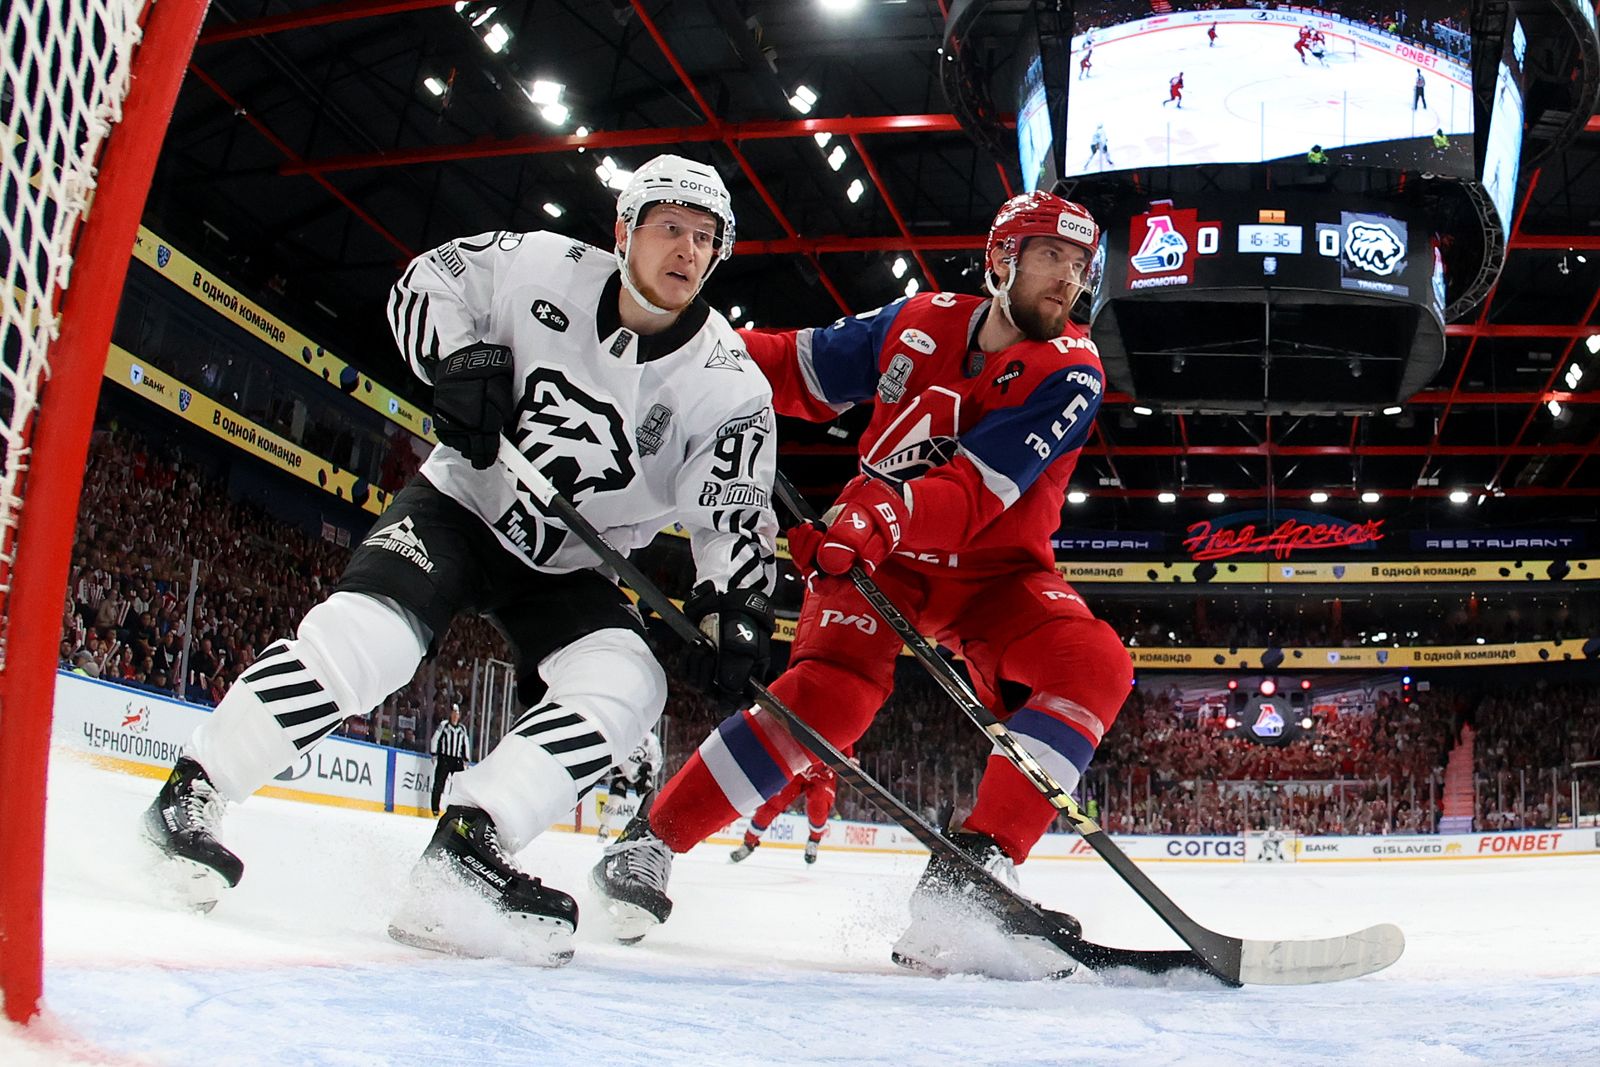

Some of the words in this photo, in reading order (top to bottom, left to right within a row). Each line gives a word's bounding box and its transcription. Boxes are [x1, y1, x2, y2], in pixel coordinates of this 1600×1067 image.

[1395, 43, 1438, 68] FONBET
[680, 178, 719, 198] согаз
[1060, 219, 1093, 237] согаз
[1197, 227, 1219, 255] 0
[1319, 229, 1340, 257] 0
[1131, 275, 1188, 289] ЛОКОМОТИВ
[193, 271, 202, 288] В
[202, 280, 239, 313] одной
[239, 304, 286, 343] команде
[1051, 393, 1089, 441] 5
[212, 409, 222, 426] В
[222, 416, 257, 444] одной
[257, 435, 302, 468] команде
[710, 431, 765, 481] 97
[1050, 540, 1149, 549] ЕСТОРАН
[1426, 538, 1573, 548] RESTAURANT
[382, 538, 435, 574] ИНТЕРПОЛ
[1069, 567, 1123, 577] команде
[1371, 567, 1379, 576] В
[1381, 565, 1421, 577] одной
[1423, 566, 1477, 577] команде
[1139, 653, 1192, 663] команде
[1414, 651, 1422, 661] В
[1424, 650, 1462, 662] одной
[1464, 649, 1517, 661] команде
[317, 753, 373, 786] LADA
[1167, 840, 1246, 857] согаз
[1305, 844, 1339, 853] БАНК
[1372, 844, 1442, 855] GISLAVED
[1477, 833, 1563, 854] FONBET
